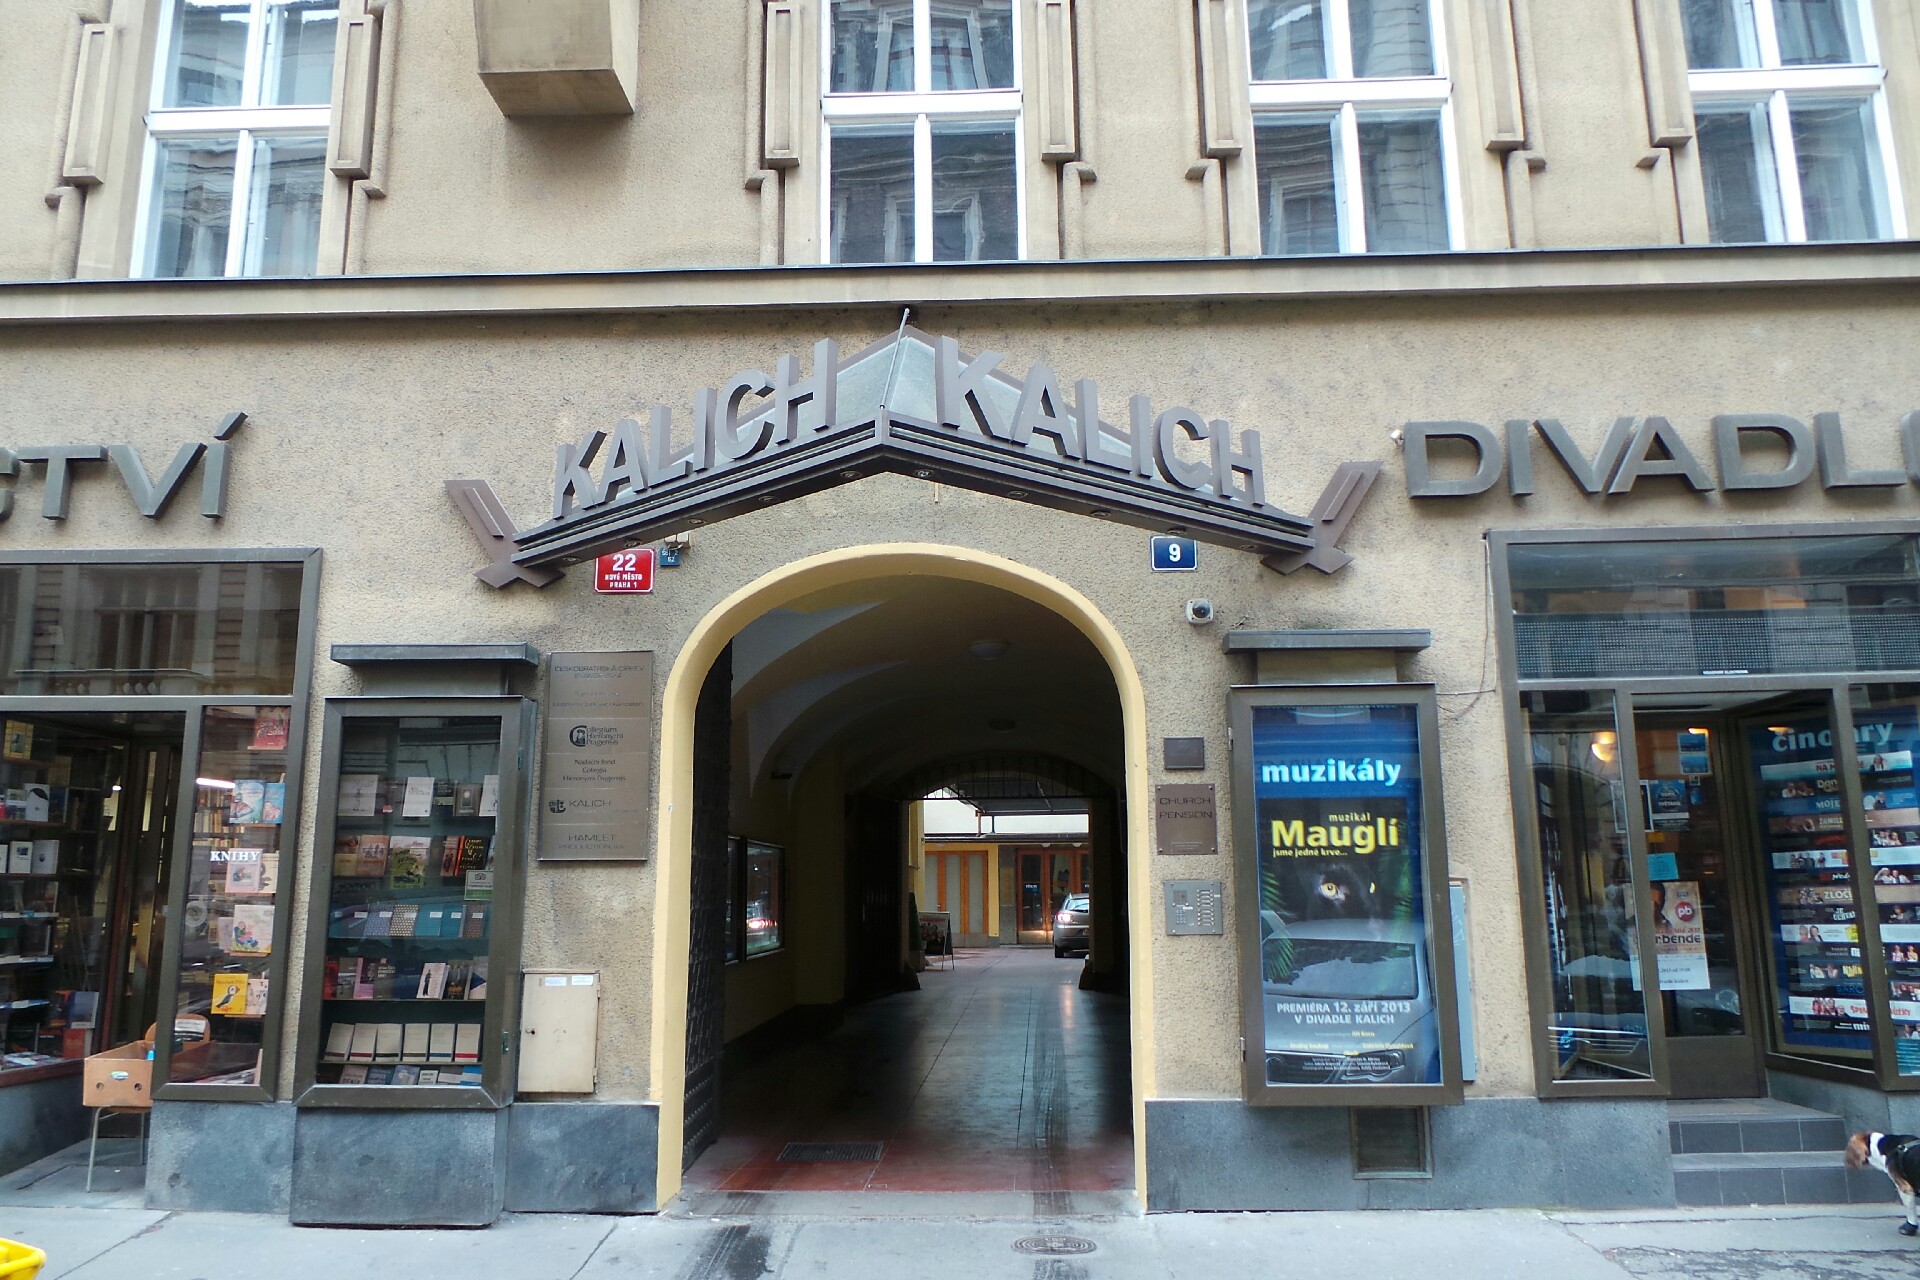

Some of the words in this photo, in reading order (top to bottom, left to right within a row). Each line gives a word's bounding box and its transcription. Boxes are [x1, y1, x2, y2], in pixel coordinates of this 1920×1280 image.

[935, 335, 1266, 507] KALICH
[553, 338, 838, 520] KALICH
[1402, 409, 1920, 499] DIVADL
[1168, 543, 1181, 562] 9
[612, 553, 637, 572] 22
[604, 572, 621, 581] NOVÉ
[622, 572, 643, 581] MĚSTO
[1262, 758, 1401, 786] muzikály
[568, 799, 612, 808] KALICH
[1159, 797, 1211, 805] CHURCH
[1159, 811, 1213, 819] PENSION
[1328, 812, 1370, 822] muzikál
[1271, 817, 1399, 854] Mauglí
[209, 850, 260, 862] KNIHY
[1273, 848, 1293, 858] jsme
[1677, 905, 1693, 918] pb
[1276, 1002, 1331, 1013] PREMIÉRA
[1333, 1001, 1351, 1013] 12.
[1381, 1002, 1411, 1013] 2013
[1294, 1015, 1302, 1024] V
[1305, 1014, 1351, 1024] DIVADLE
[1355, 1014, 1395, 1024] KALICH
